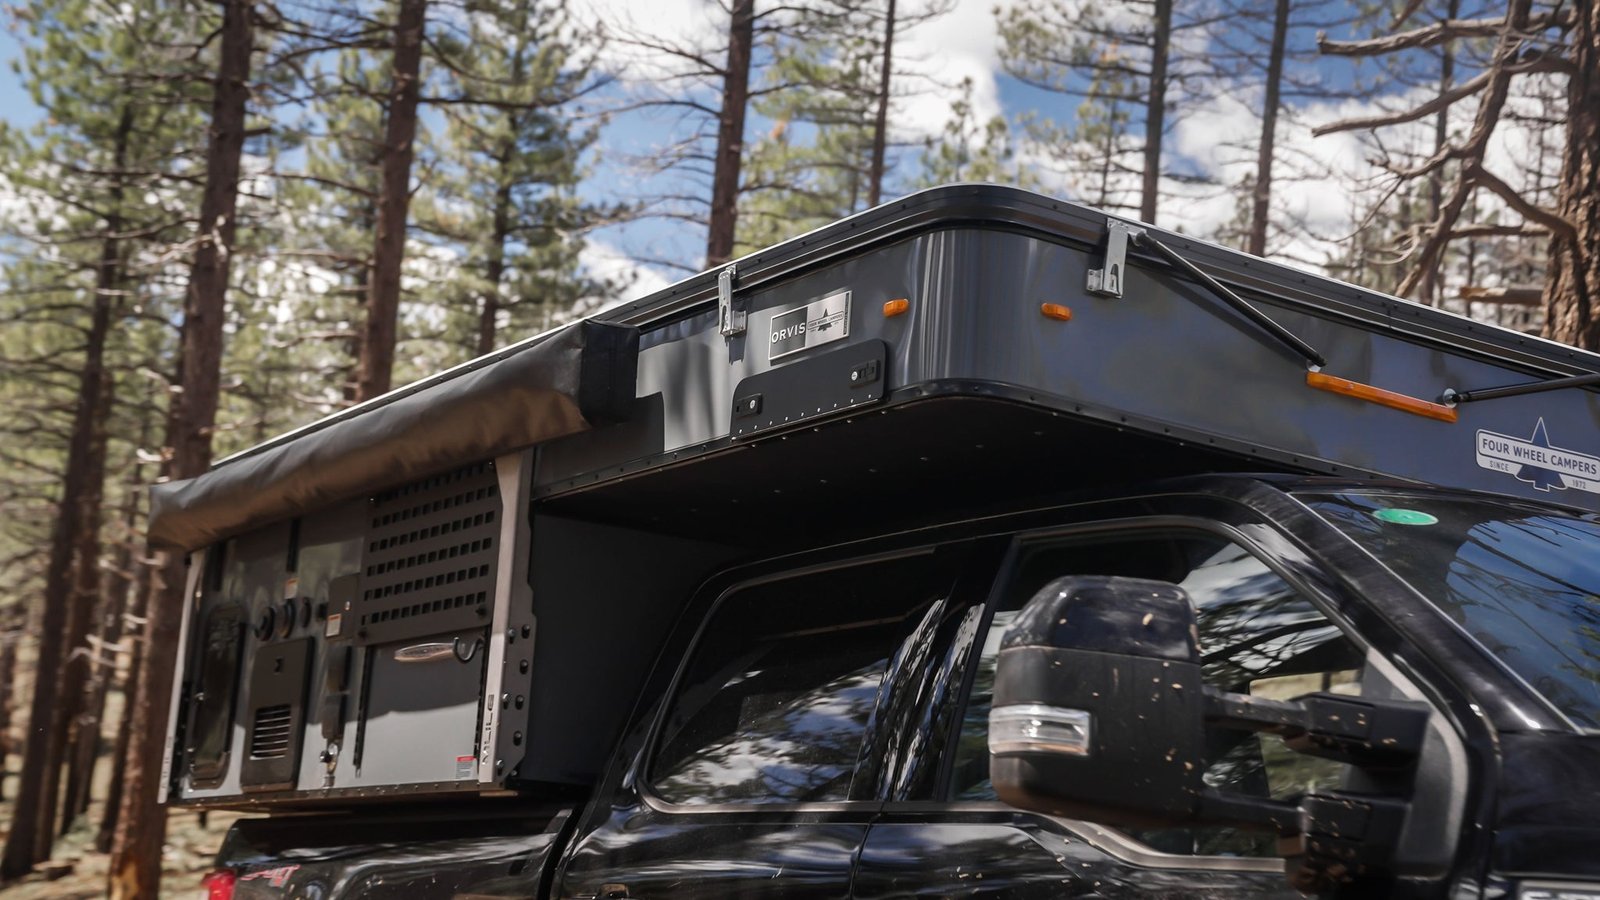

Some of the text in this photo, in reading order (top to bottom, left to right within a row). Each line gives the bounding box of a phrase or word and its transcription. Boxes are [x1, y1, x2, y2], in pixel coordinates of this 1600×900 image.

[771, 322, 806, 343] ORVIS
[1482, 438, 1597, 475] FOUR WHEEL CAMPERS
[1489, 460, 1509, 472] SINCE
